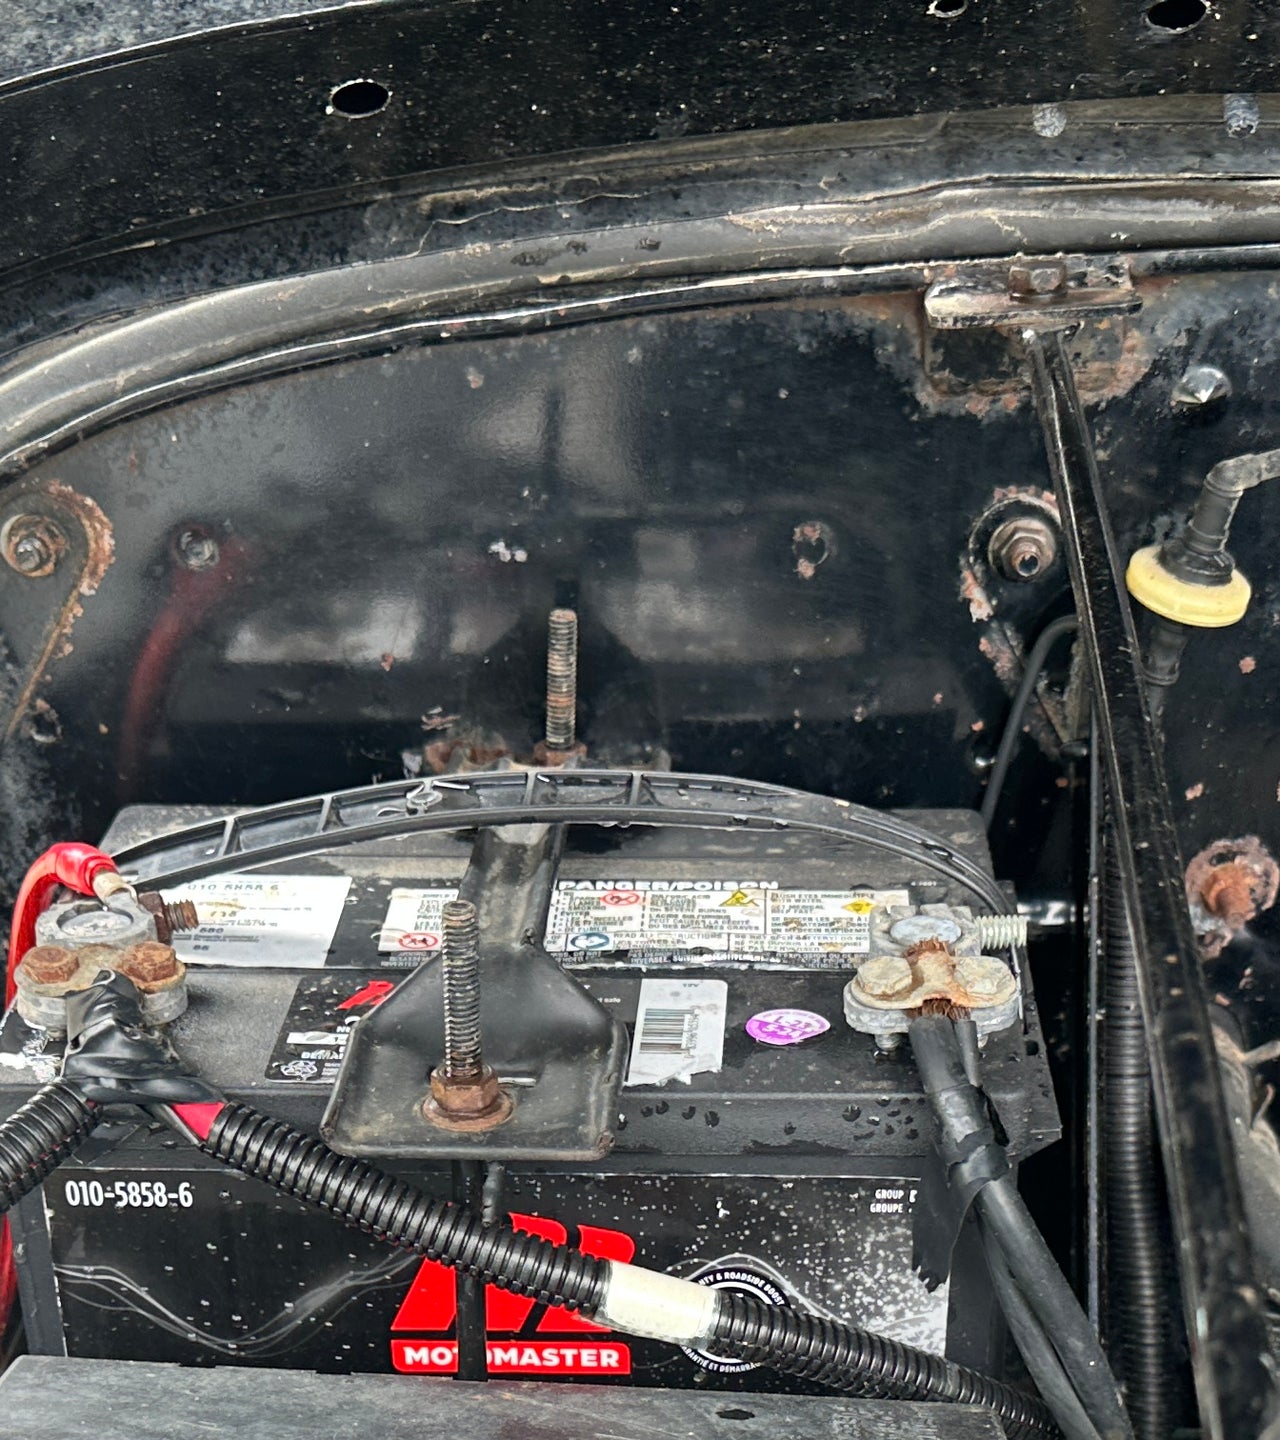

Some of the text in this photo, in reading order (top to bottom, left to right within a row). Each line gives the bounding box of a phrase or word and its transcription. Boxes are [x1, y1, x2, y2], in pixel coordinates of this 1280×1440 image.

[65, 1180, 193, 1208] 010-5858-6
[875, 1188, 904, 1199] GROUP
[870, 1202, 904, 1213] GROUPE
[724, 1271, 765, 1288] ROADSIDE
[763, 1283, 786, 1306] BOOST
[403, 1345, 620, 1368] MOMASTER
[681, 1345, 710, 1368] ARANTIE
